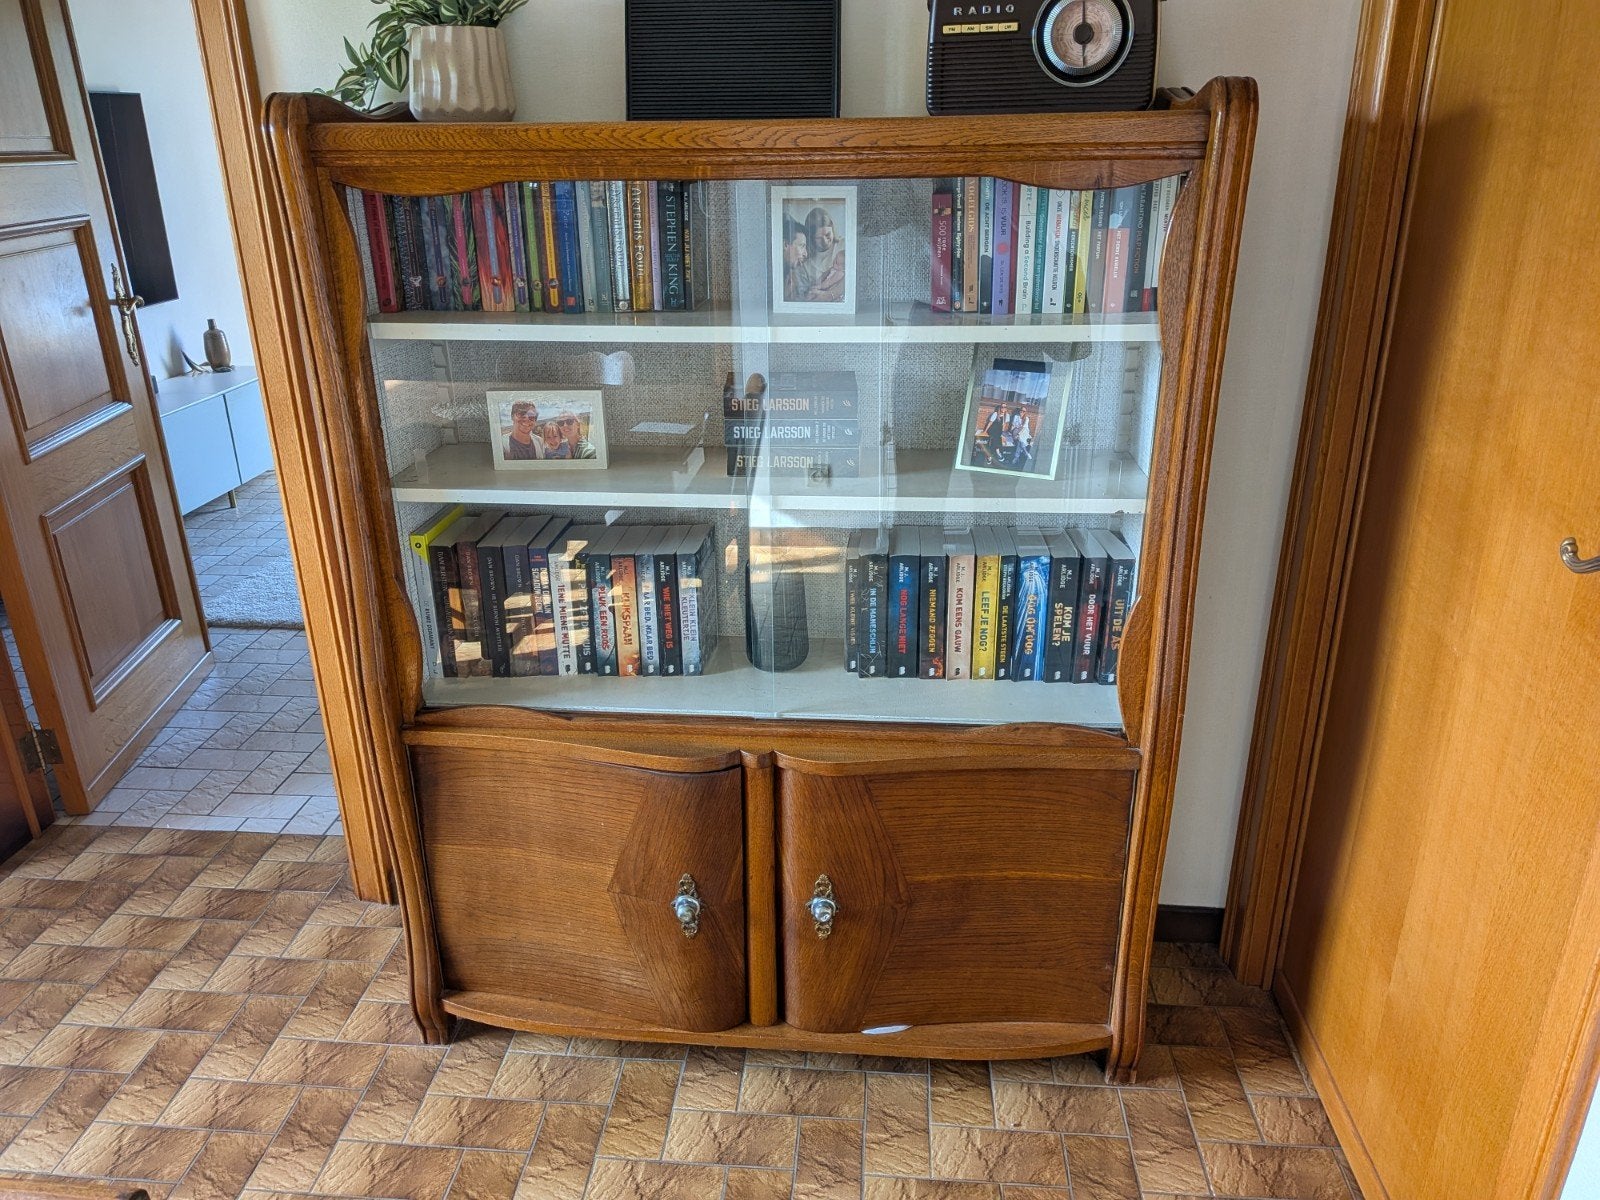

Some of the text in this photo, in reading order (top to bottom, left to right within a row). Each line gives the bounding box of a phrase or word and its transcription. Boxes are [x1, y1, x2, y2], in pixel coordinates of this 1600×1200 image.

[953, 4, 1015, 16] RADIO
[968, 180, 976, 233] VOGELGIDS
[665, 195, 678, 252] STEPHEN
[938, 220, 947, 236] 500
[1000, 215, 1008, 236] VUUR
[1023, 220, 1031, 249] Building
[668, 264, 680, 295] KING
[731, 399, 759, 411] STIEG
[763, 398, 809, 411] LARSSON
[733, 426, 761, 439] STIEG
[764, 426, 811, 439] LARSSON
[736, 455, 764, 468] STIEG
[768, 455, 814, 469] LARSSON
[531, 568, 542, 596] SCHADUW
[559, 606, 568, 630] MIENE
[598, 586, 610, 650] PLUK EEN ROOS
[621, 592, 633, 646] KLIKSPAAN
[662, 587, 673, 649] WIE NIET WEG IS
[681, 596, 690, 641] KLEUTERTJE
[869, 588, 877, 653] IN DE MANESCHIJN
[898, 589, 908, 654] NOG LANGE NIET
[928, 589, 937, 653] NIEMAND ZEGGEN
[954, 588, 964, 653] KOM EENS GAUW
[979, 590, 990, 652] LEEF JE NOG?
[1002, 605, 1009, 614] DE
[1052, 602, 1063, 647] SPELEN?
[1061, 606, 1073, 642] KOM JE
[1083, 594, 1096, 655] DOOR HET VUUR
[1111, 599, 1125, 651] UIT DE AS
[426, 624, 435, 649] DIAMANT
[561, 632, 571, 659] MUTTE
[645, 625, 654, 644] NAAR
[1024, 635, 1034, 655] OOG
[647, 646, 655, 660] BED
